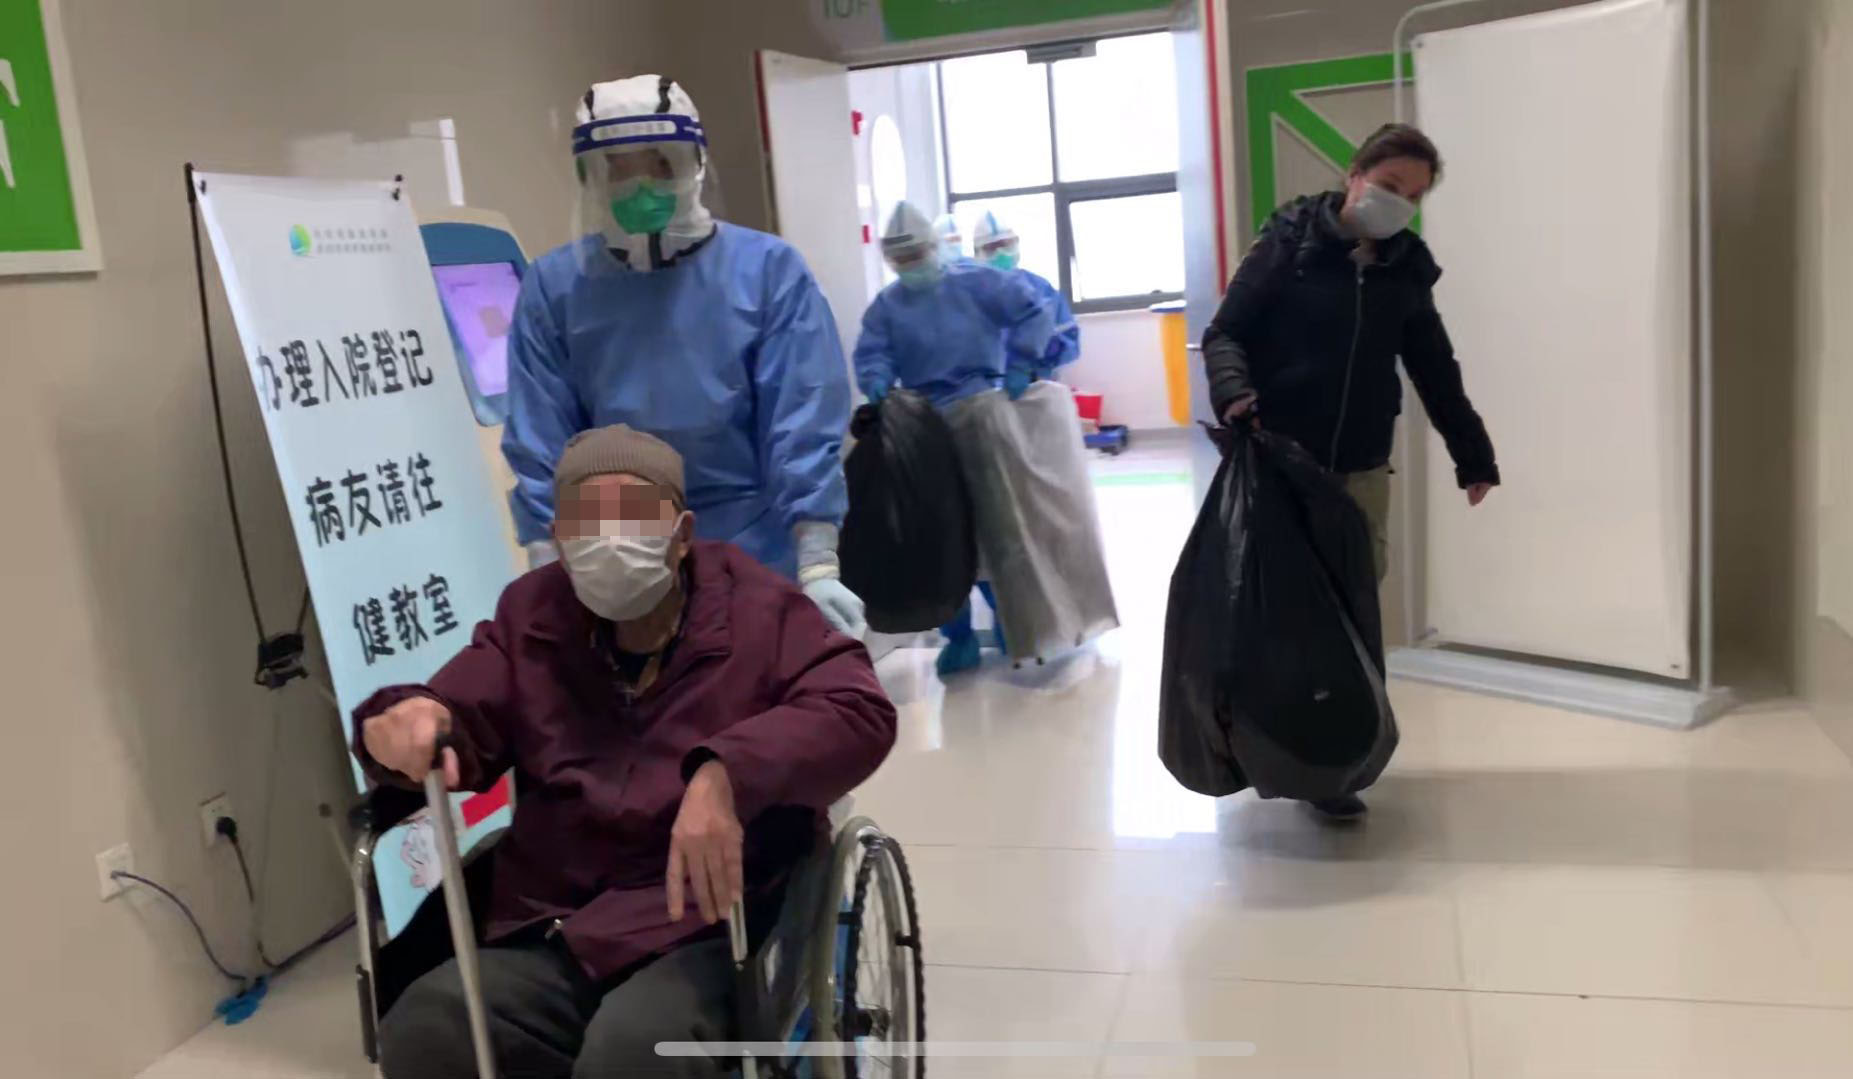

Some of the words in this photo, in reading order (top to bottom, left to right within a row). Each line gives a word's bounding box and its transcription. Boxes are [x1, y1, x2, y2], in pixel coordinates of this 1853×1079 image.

[305, 452, 443, 547] 病友请往
[352, 573, 458, 666] 健教室
